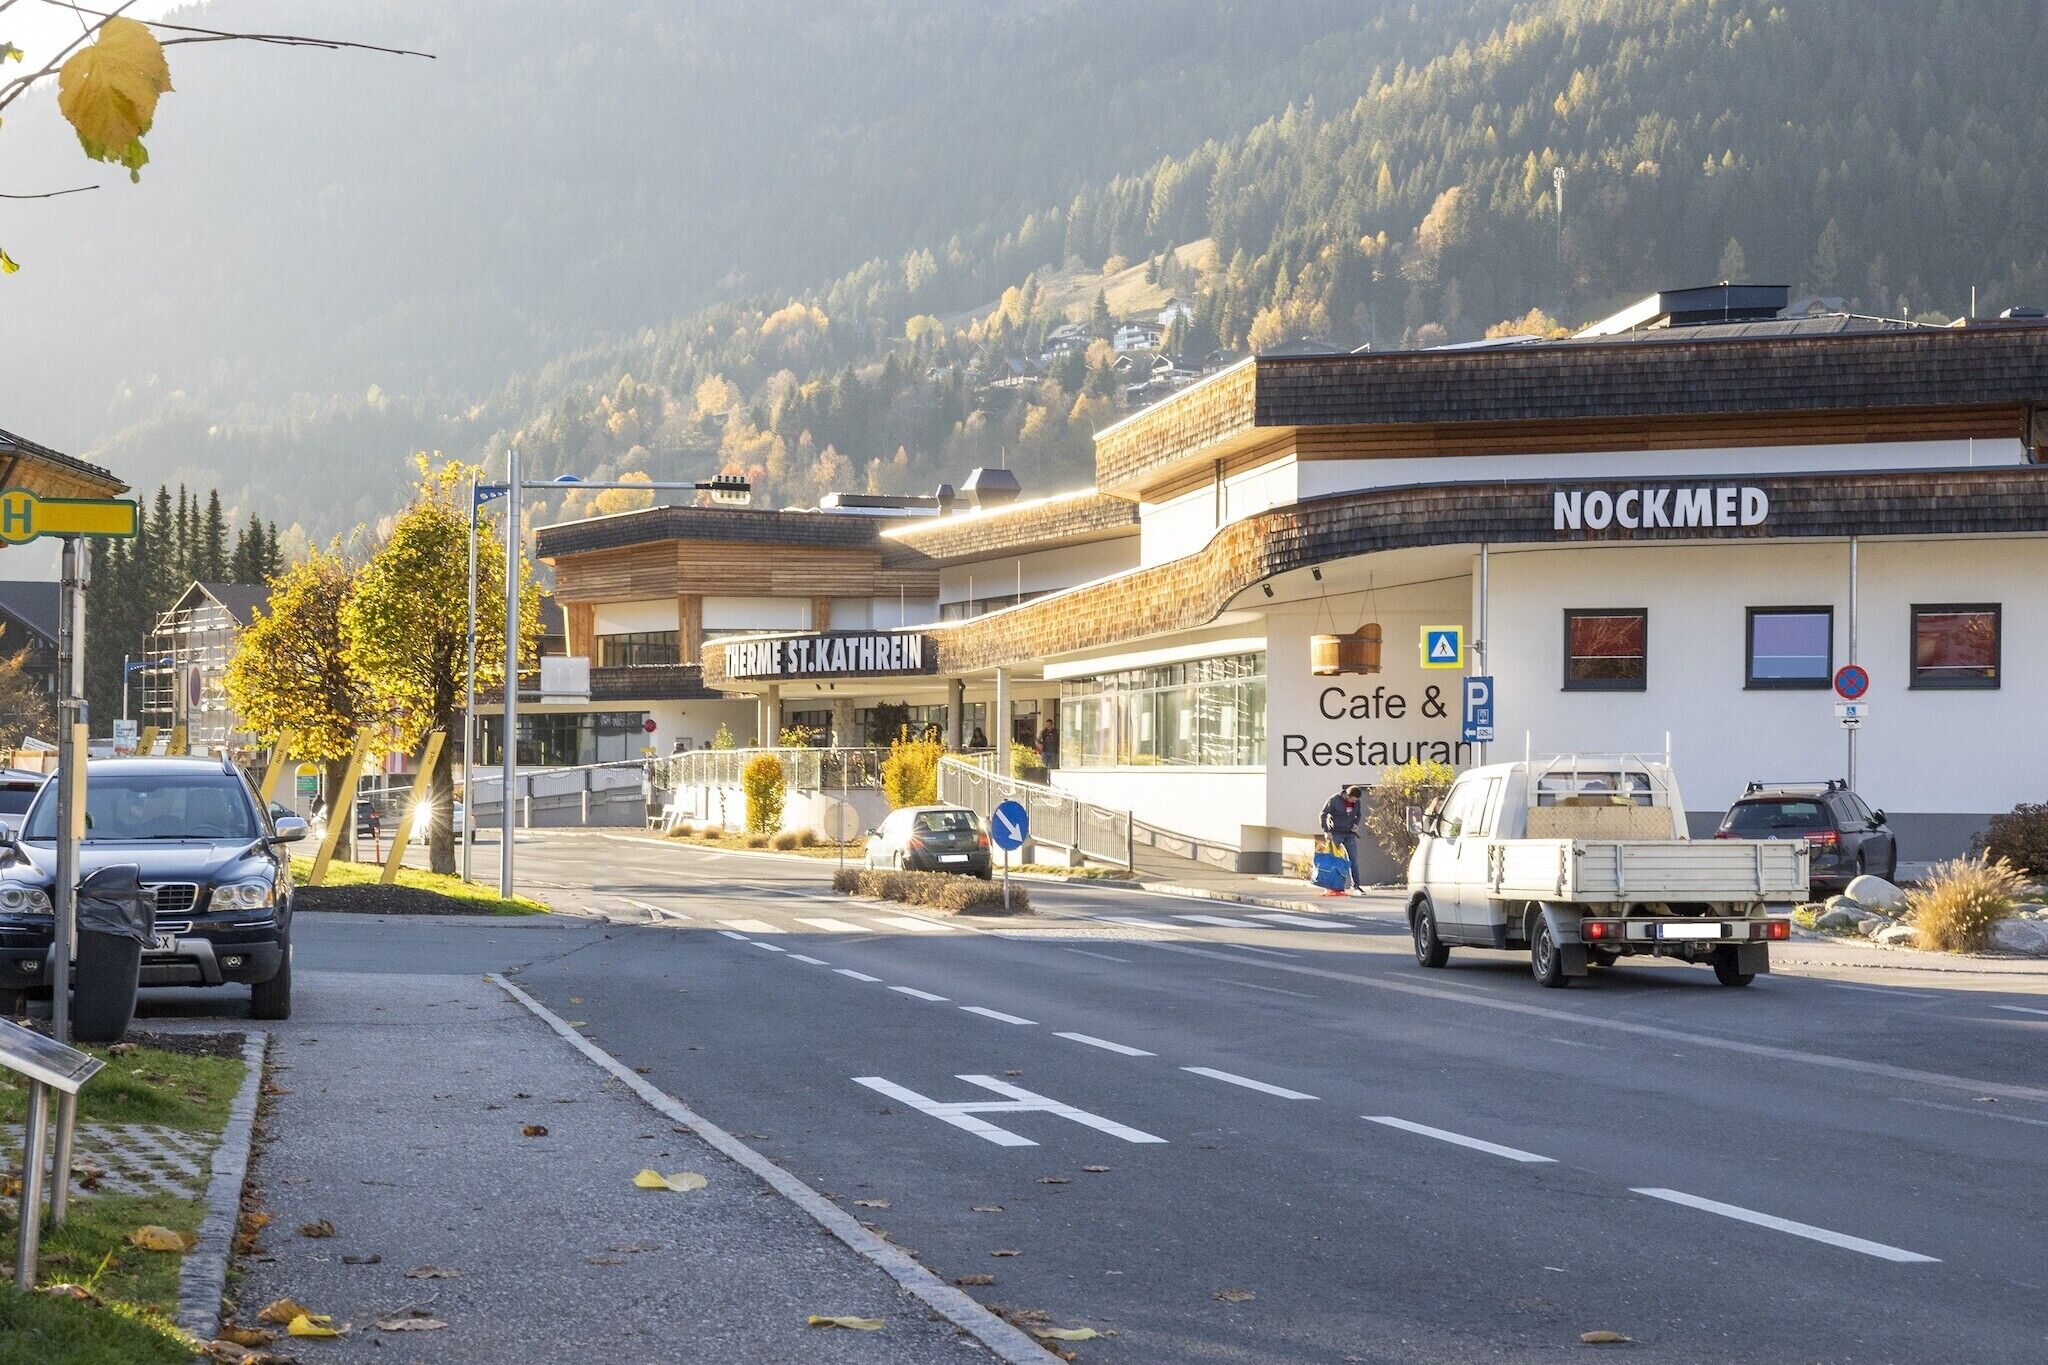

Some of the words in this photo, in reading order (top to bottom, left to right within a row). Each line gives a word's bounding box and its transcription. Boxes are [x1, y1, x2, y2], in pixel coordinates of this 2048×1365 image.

[4, 499, 31, 533] H
[1554, 487, 1769, 530] NOCKMED
[725, 641, 782, 677] THERME
[787, 634, 922, 673] ST.KATHREIN
[1319, 686, 1406, 720] Cafe
[1421, 685, 1448, 719] &
[1468, 682, 1489, 722] P
[1283, 735, 1471, 767] Restauran
